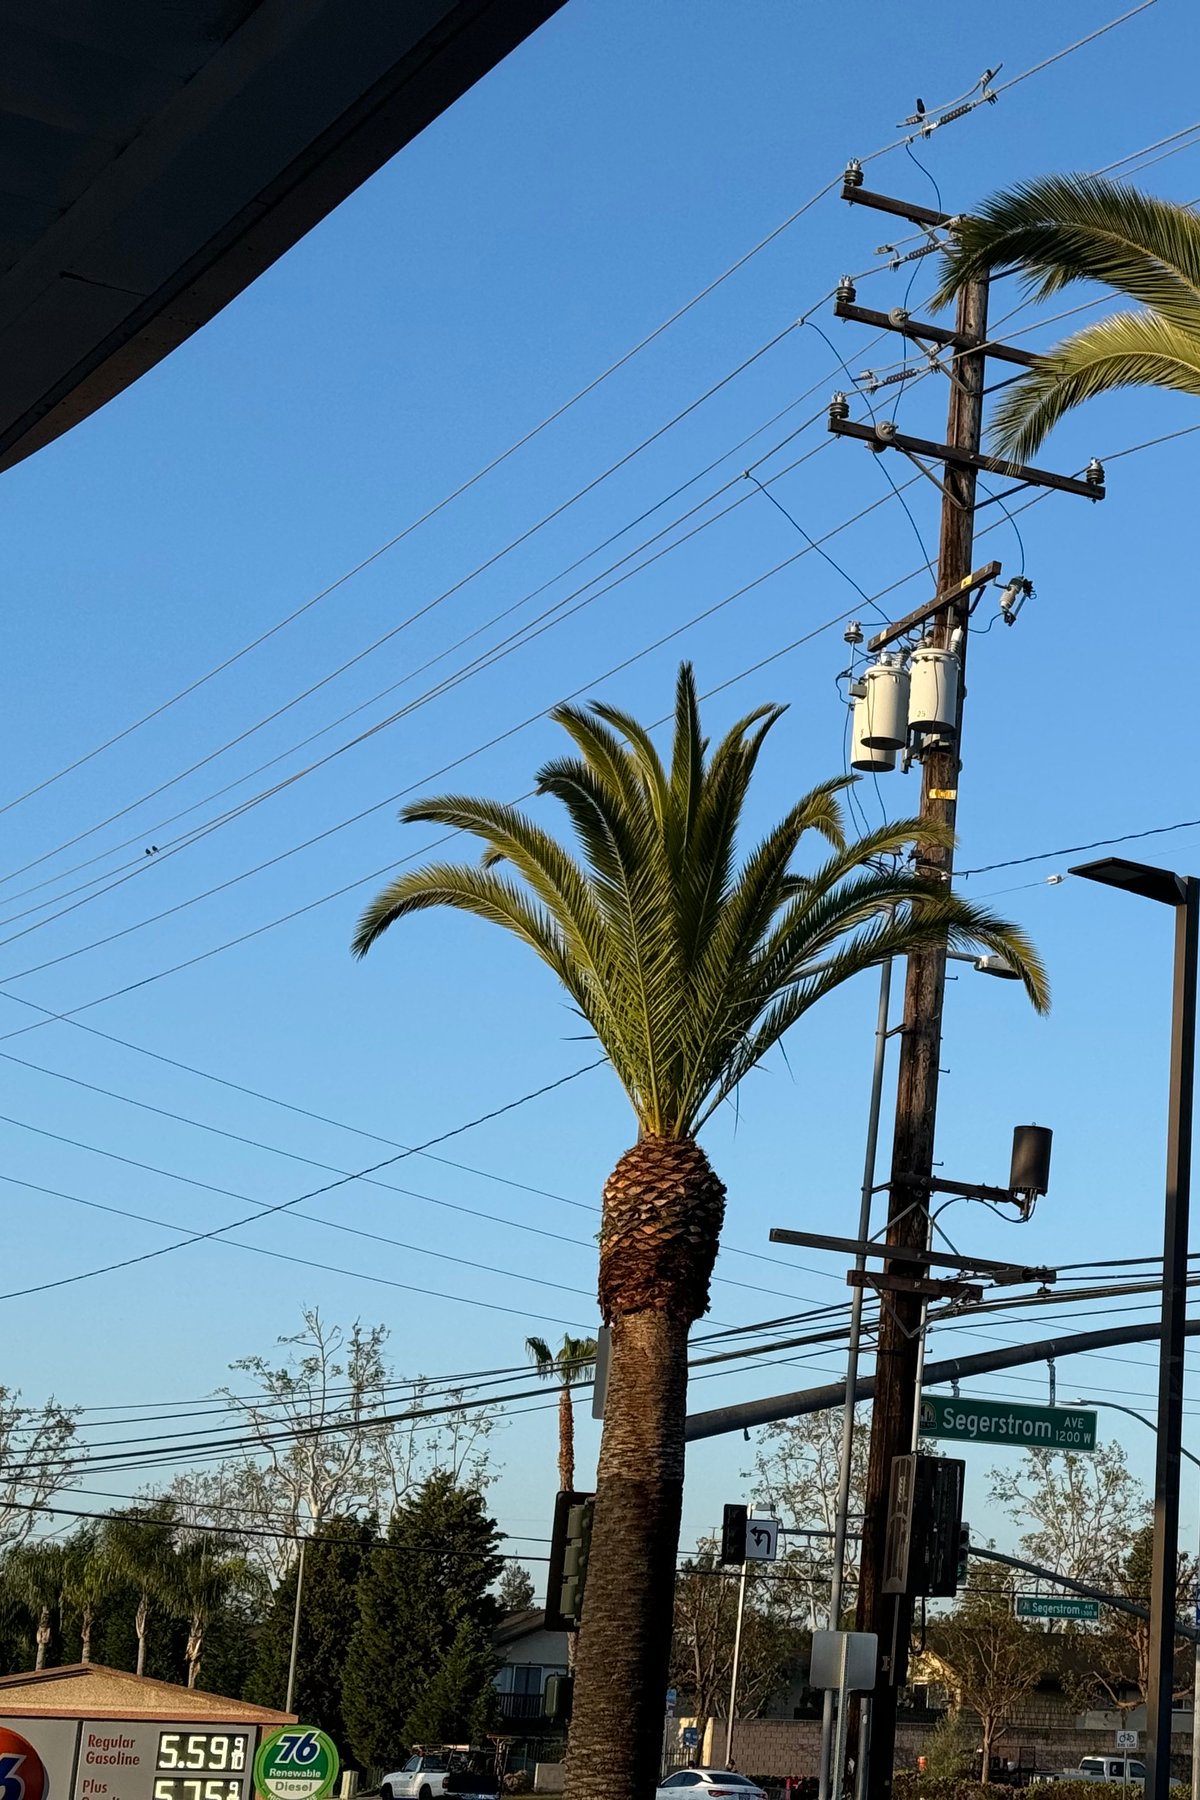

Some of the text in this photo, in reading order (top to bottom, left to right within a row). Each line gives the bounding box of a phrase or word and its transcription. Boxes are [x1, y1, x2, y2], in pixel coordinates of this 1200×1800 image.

[942, 1408, 1052, 1438] Segerstrom
[1063, 1416, 1085, 1429] AVE
[1055, 1430, 1092, 1444] 1200 W
[1032, 1602, 1080, 1616] Segerstrom
[88, 1734, 136, 1751] Regular
[159, 1735, 229, 1770] 5.59
[274, 1730, 321, 1765] 76
[86, 1751, 140, 1766] Gasoline
[269, 1768, 321, 1778] Renewable
[82, 1779, 108, 1793] Plus
[275, 1782, 312, 1791] Diesel
